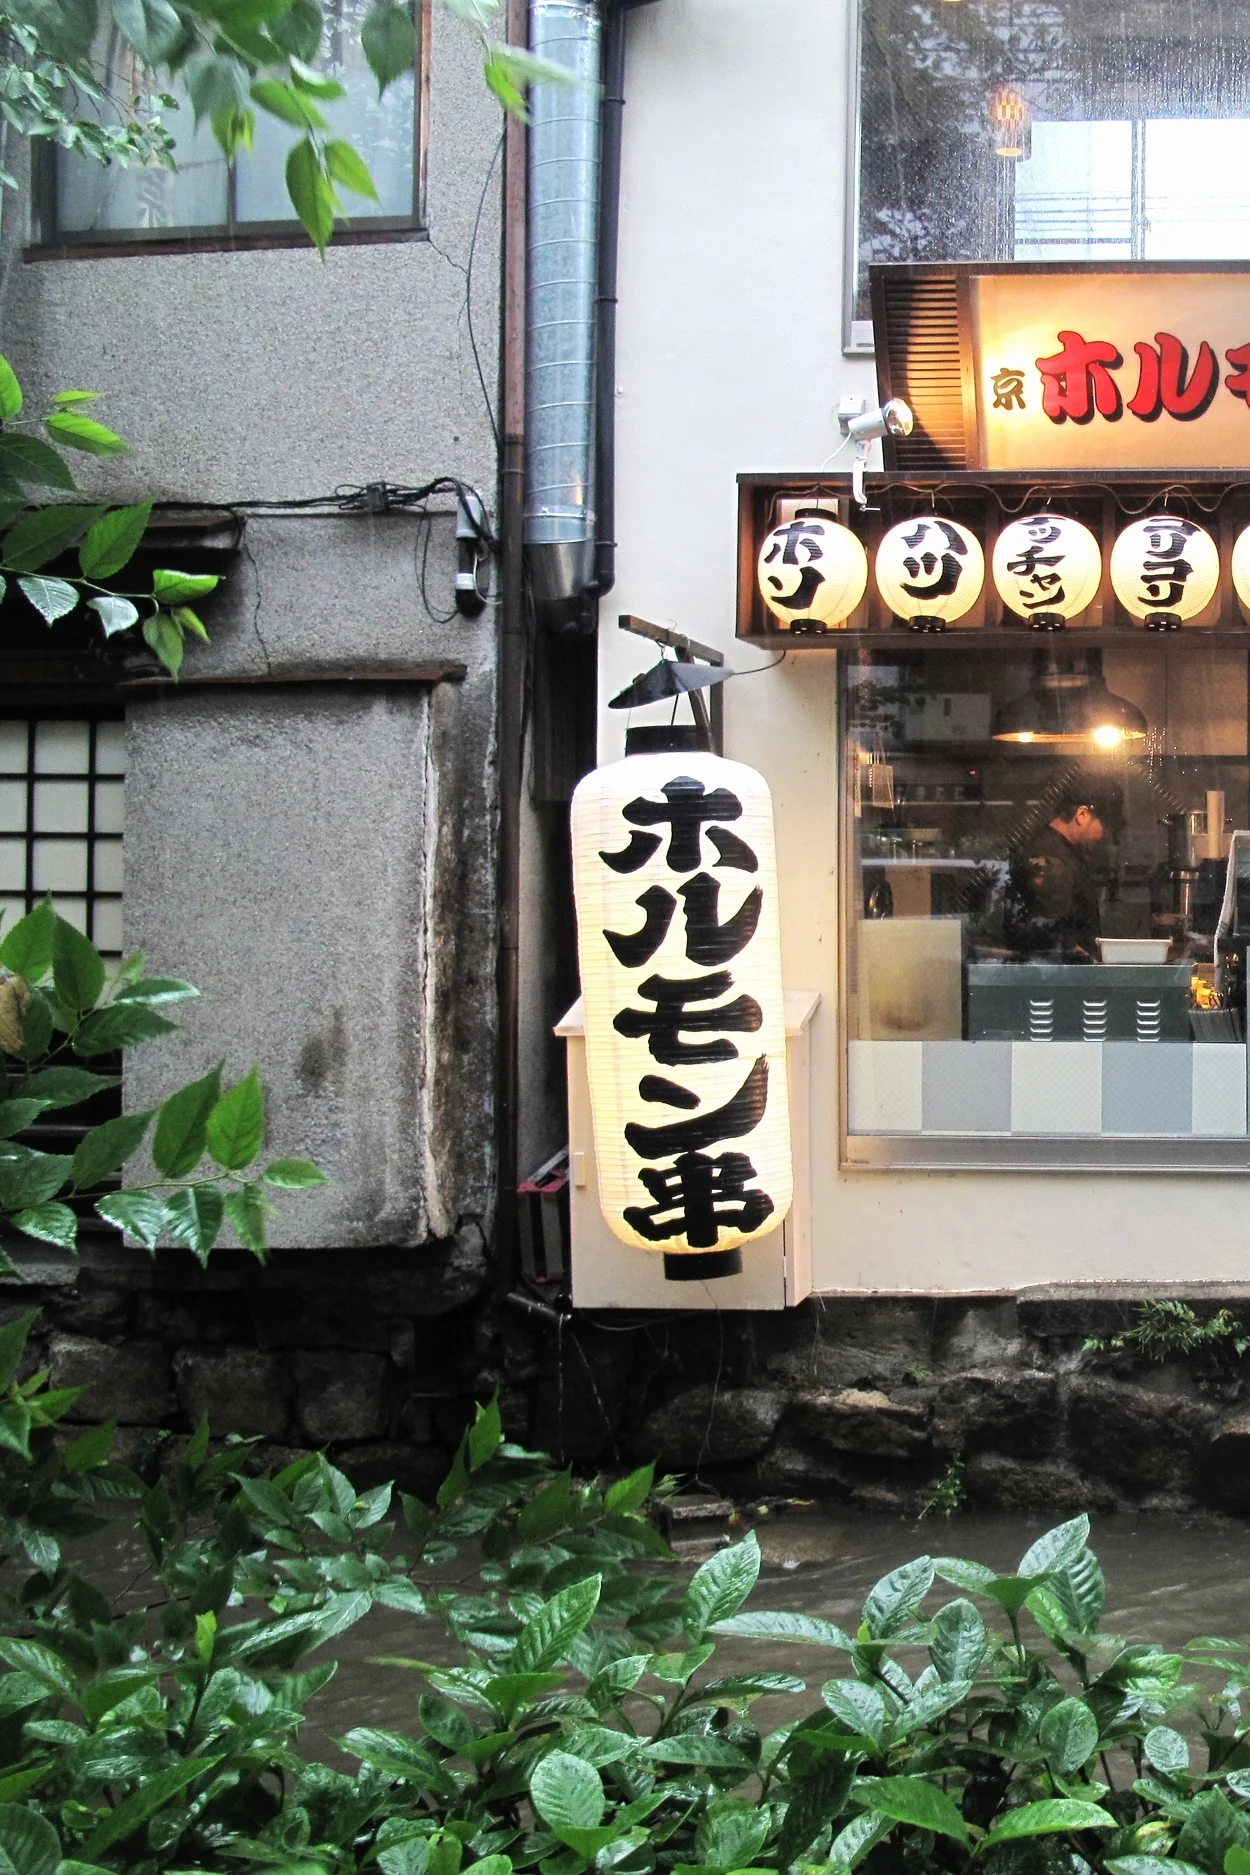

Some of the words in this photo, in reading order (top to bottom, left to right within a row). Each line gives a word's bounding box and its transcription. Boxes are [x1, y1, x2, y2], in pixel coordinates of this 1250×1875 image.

[900, 520, 968, 600] ハツ
[598, 775, 774, 1248] ホルモン串
